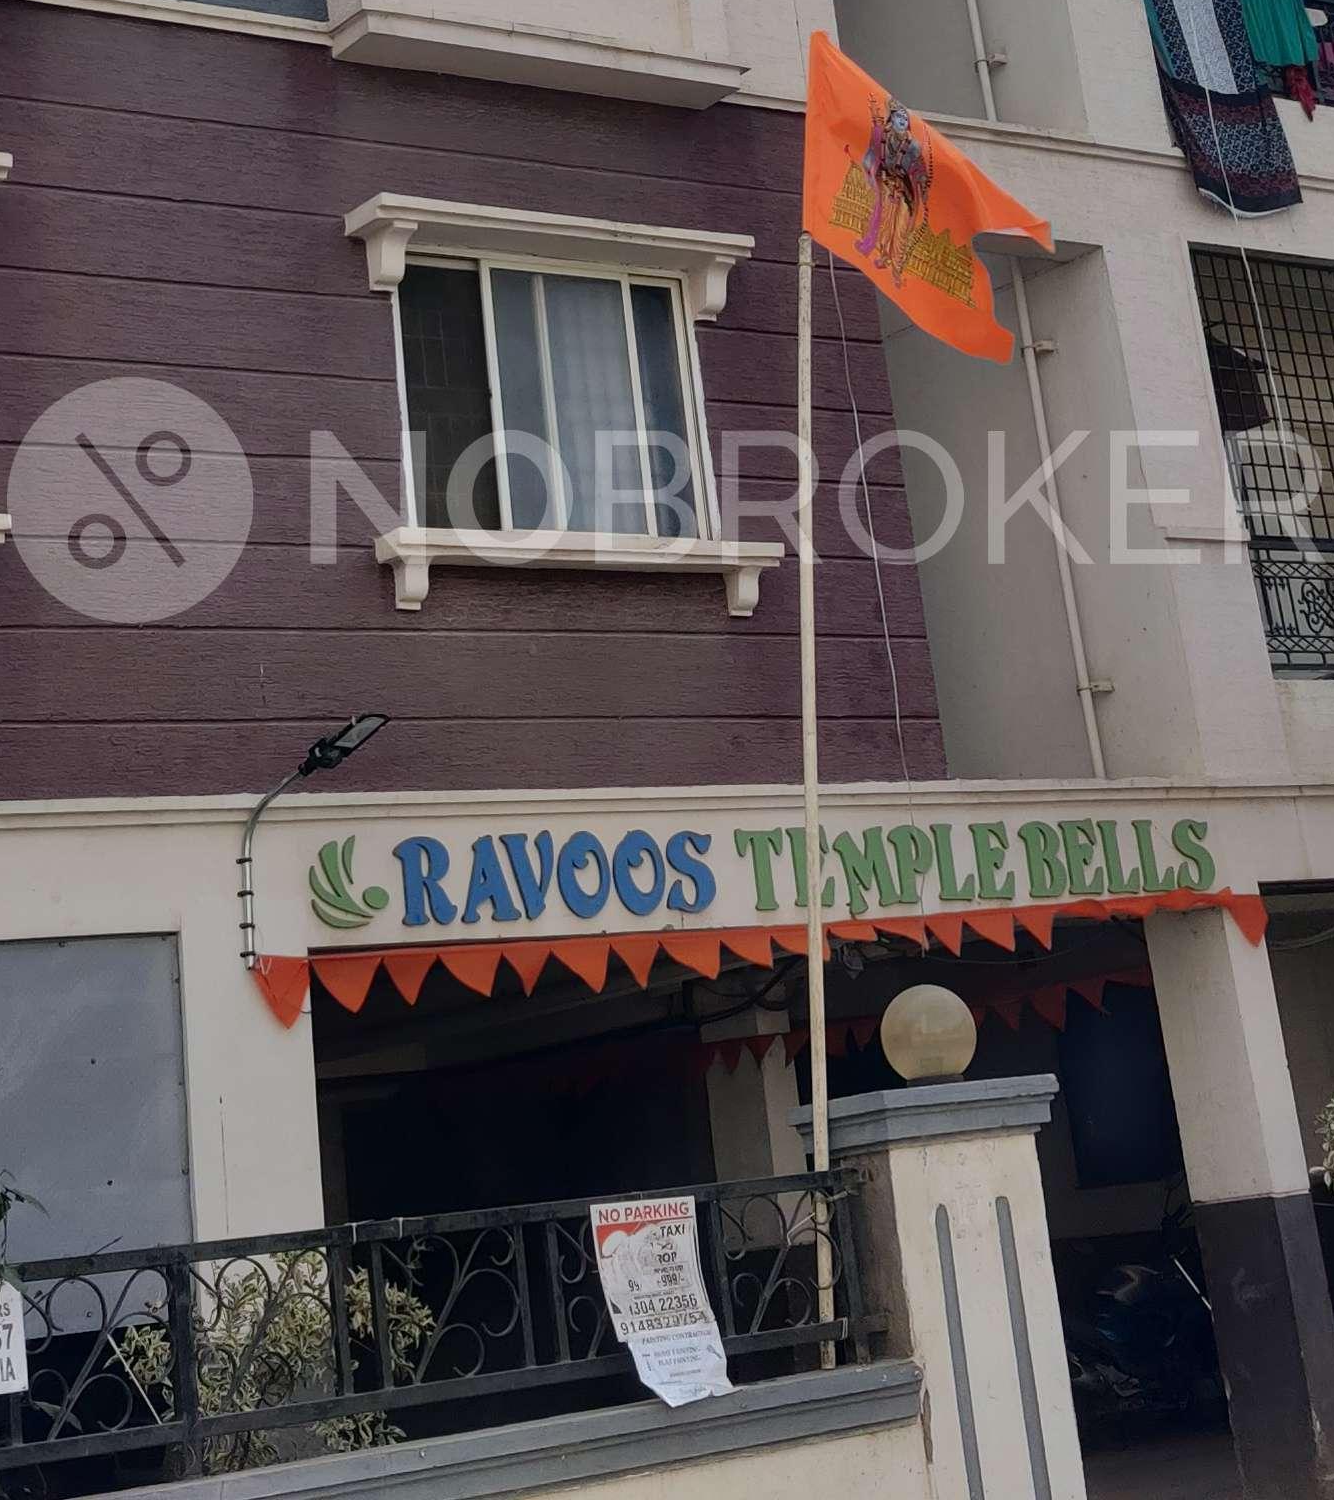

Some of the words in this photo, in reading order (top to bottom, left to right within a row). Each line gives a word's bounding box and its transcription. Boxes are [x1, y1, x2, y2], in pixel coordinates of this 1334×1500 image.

[393, 829, 717, 926] RAVOOS
[599, 1209, 620, 1223] NO
[625, 1202, 689, 1220] PARKING
[660, 1224, 684, 1237] TAXI
